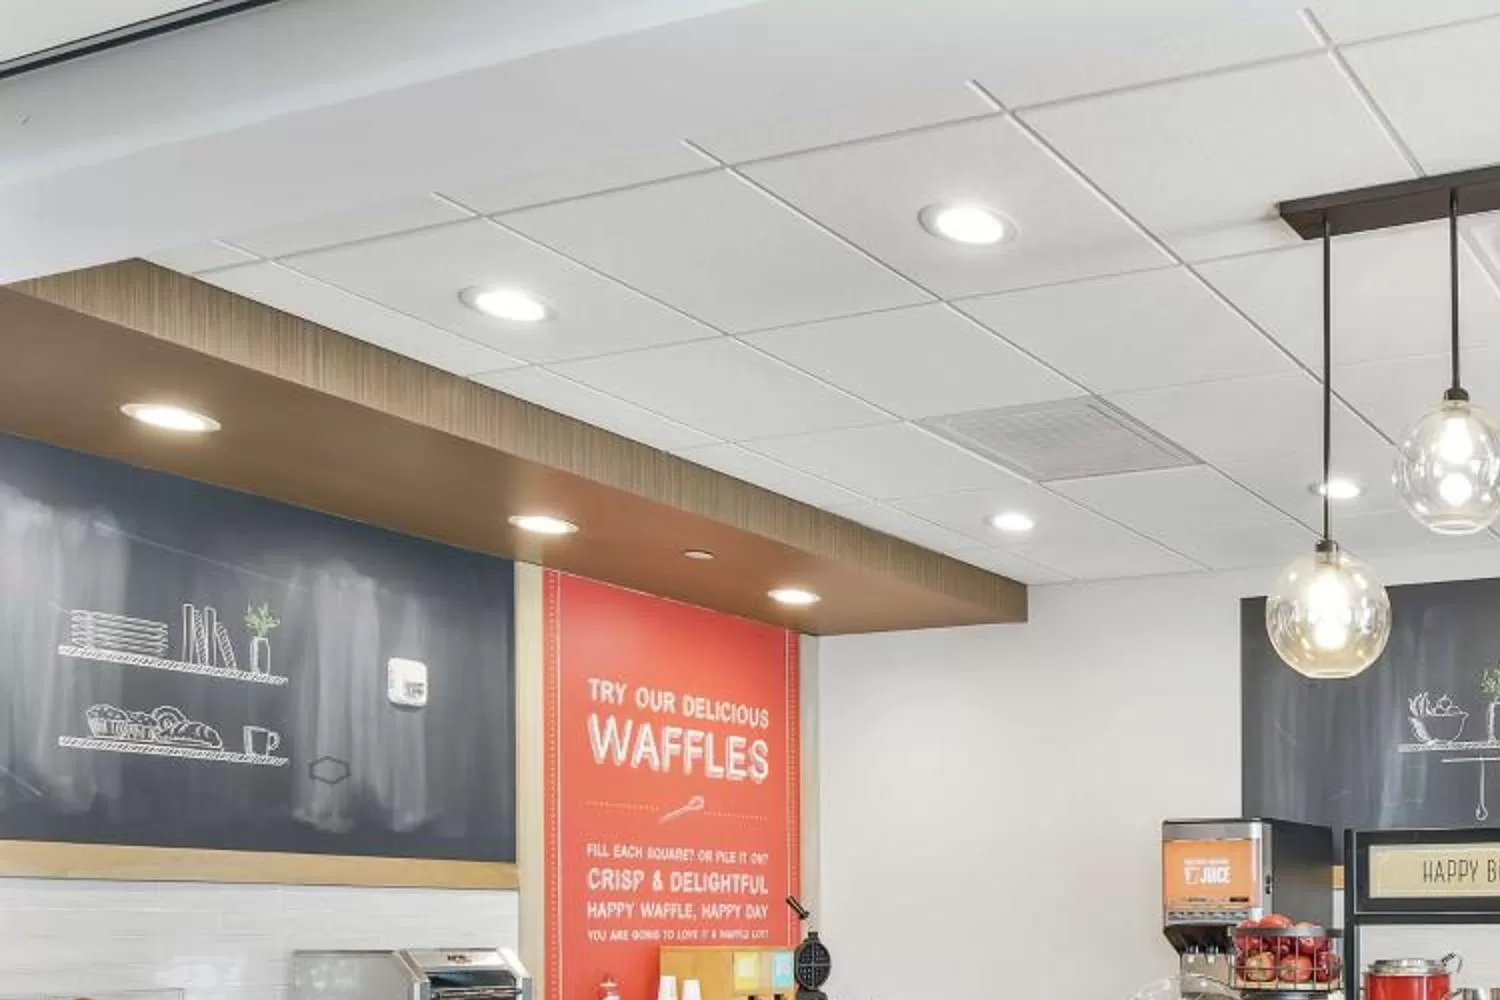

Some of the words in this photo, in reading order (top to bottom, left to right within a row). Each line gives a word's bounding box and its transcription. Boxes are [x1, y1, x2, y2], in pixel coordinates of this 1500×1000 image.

[587, 677, 628, 705] TRY
[635, 686, 676, 714] OUR
[682, 693, 769, 730] DELICIOUS
[587, 712, 769, 784] WAFFLES
[587, 843, 610, 858] FILL
[613, 845, 643, 859] EACH
[698, 850, 713, 863] OR
[587, 868, 645, 892] CRISP
[652, 869, 664, 892] &
[670, 871, 769, 895] DELIGHTFUL
[1423, 859, 1480, 883] HAPPY
[587, 902, 635, 920] HAPPY
[640, 903, 697, 921] WAFFLE,
[701, 903, 742, 920] HAPPY
[745, 904, 769, 920] DAY
[587, 928, 606, 942] YOU
[610, 929, 629, 941] ARE
[663, 929, 675, 941] TO
